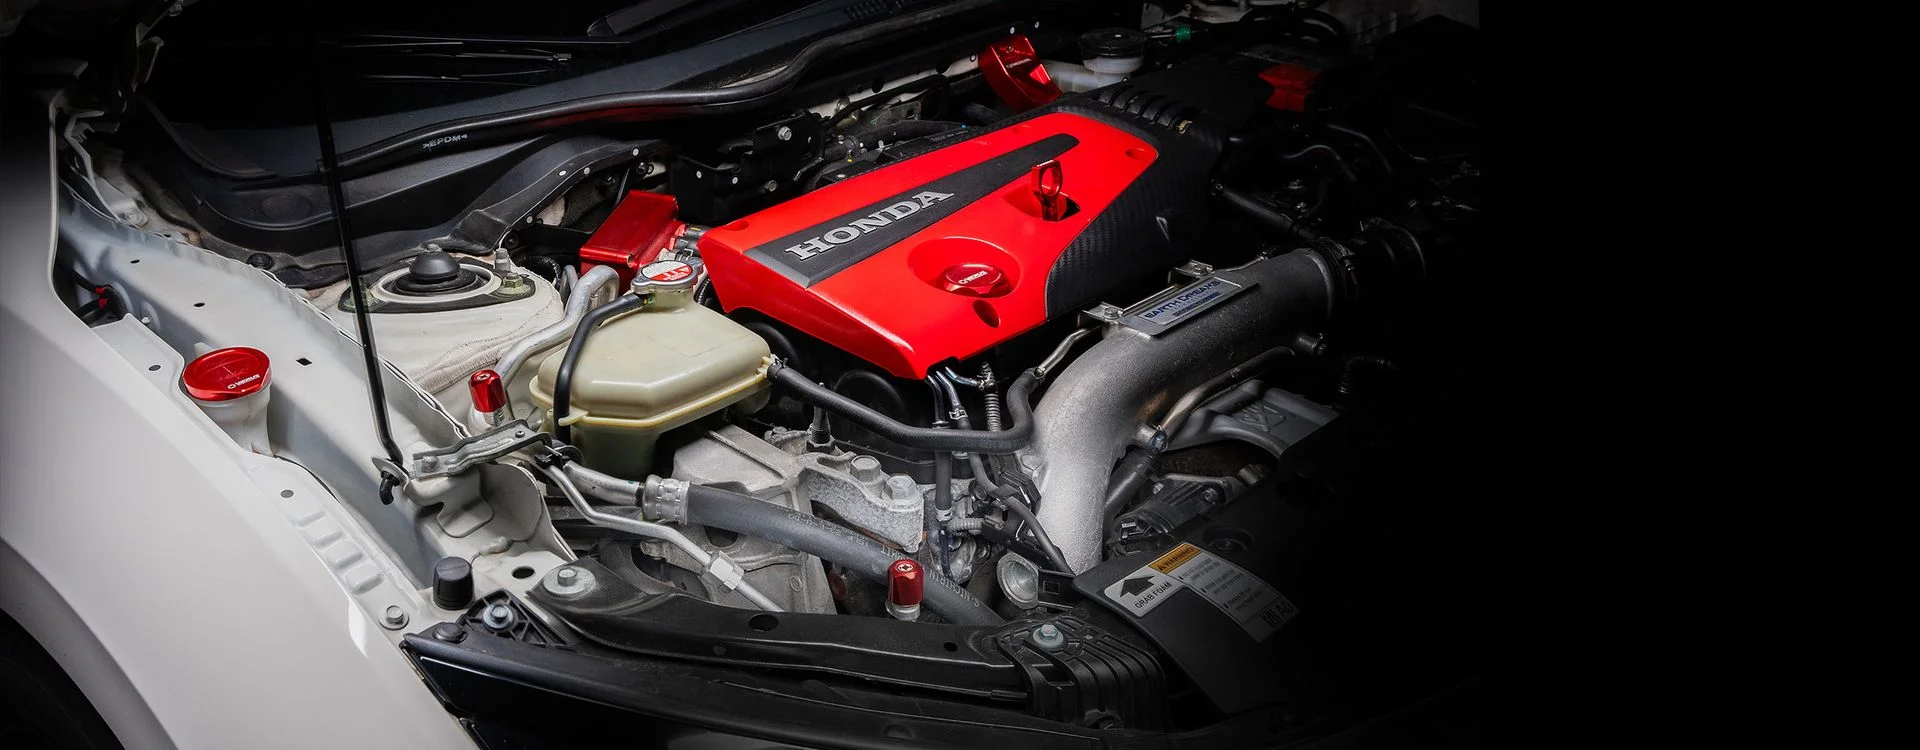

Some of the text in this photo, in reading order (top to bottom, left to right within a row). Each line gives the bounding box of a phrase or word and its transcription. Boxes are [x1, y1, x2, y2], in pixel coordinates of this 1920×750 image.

[785, 190, 955, 261] HONDA
[1145, 300, 1180, 318] EARTH
[1178, 280, 1221, 302] DREAMS
[1164, 546, 1196, 568] WARNING
[1135, 582, 1174, 609] GRAB FOAM
